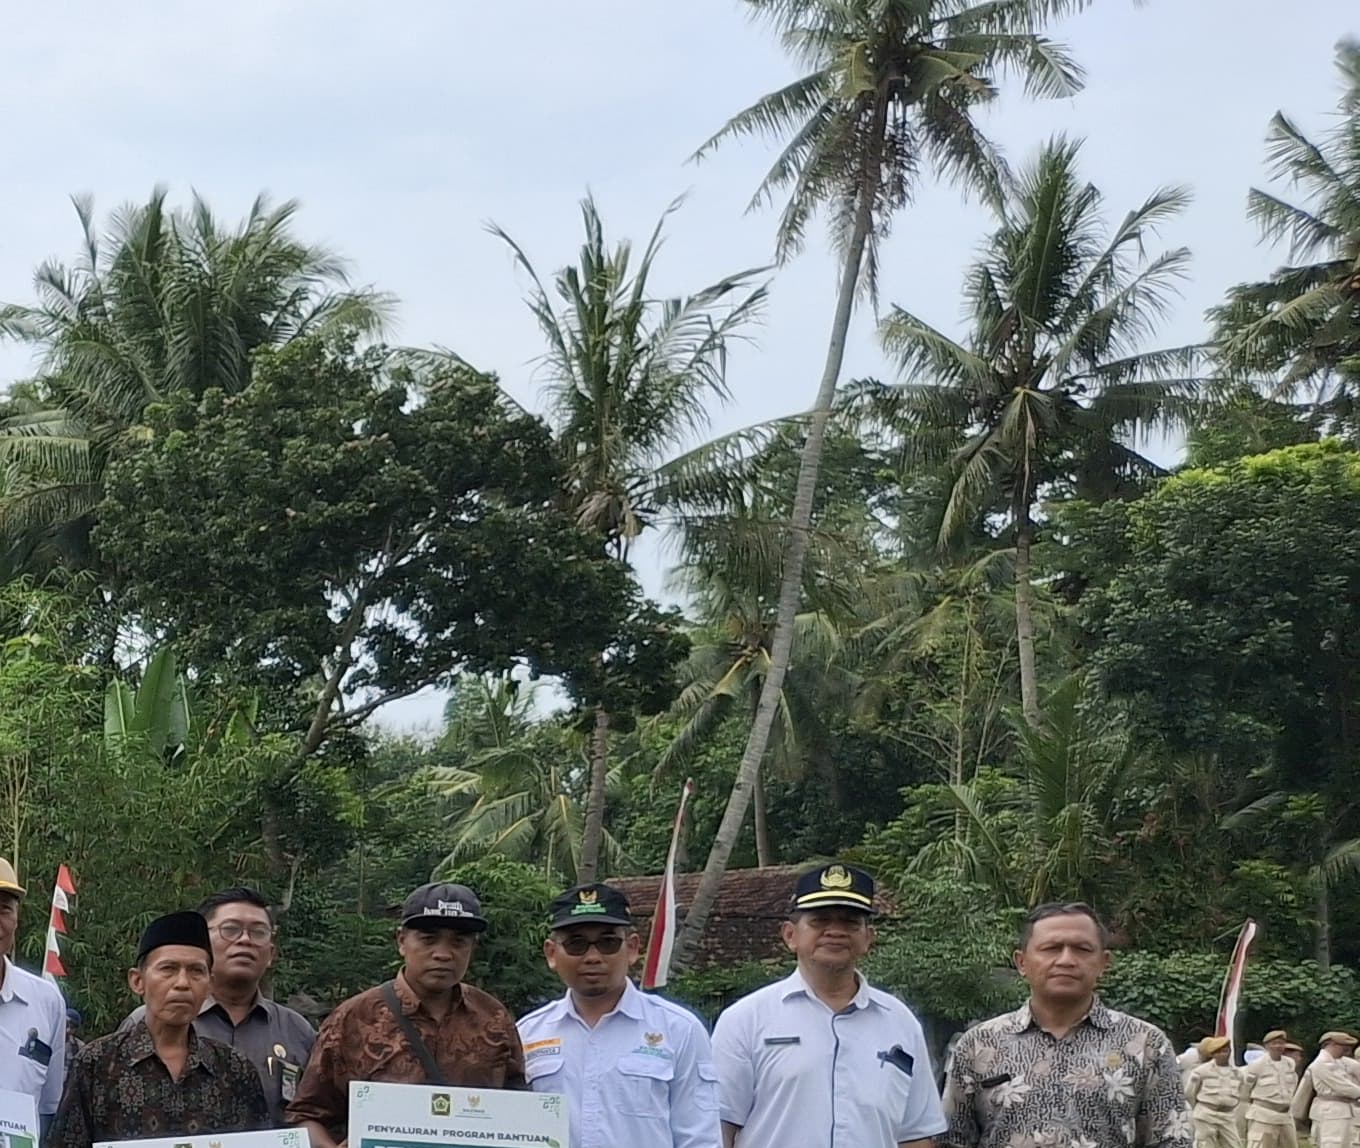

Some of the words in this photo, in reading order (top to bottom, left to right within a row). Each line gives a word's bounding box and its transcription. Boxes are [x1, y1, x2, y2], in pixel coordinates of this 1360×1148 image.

[367, 1124, 438, 1137] PENYALURAN
[442, 1129, 495, 1140] PROGRAM
[497, 1132, 550, 1143] BANTUAN
